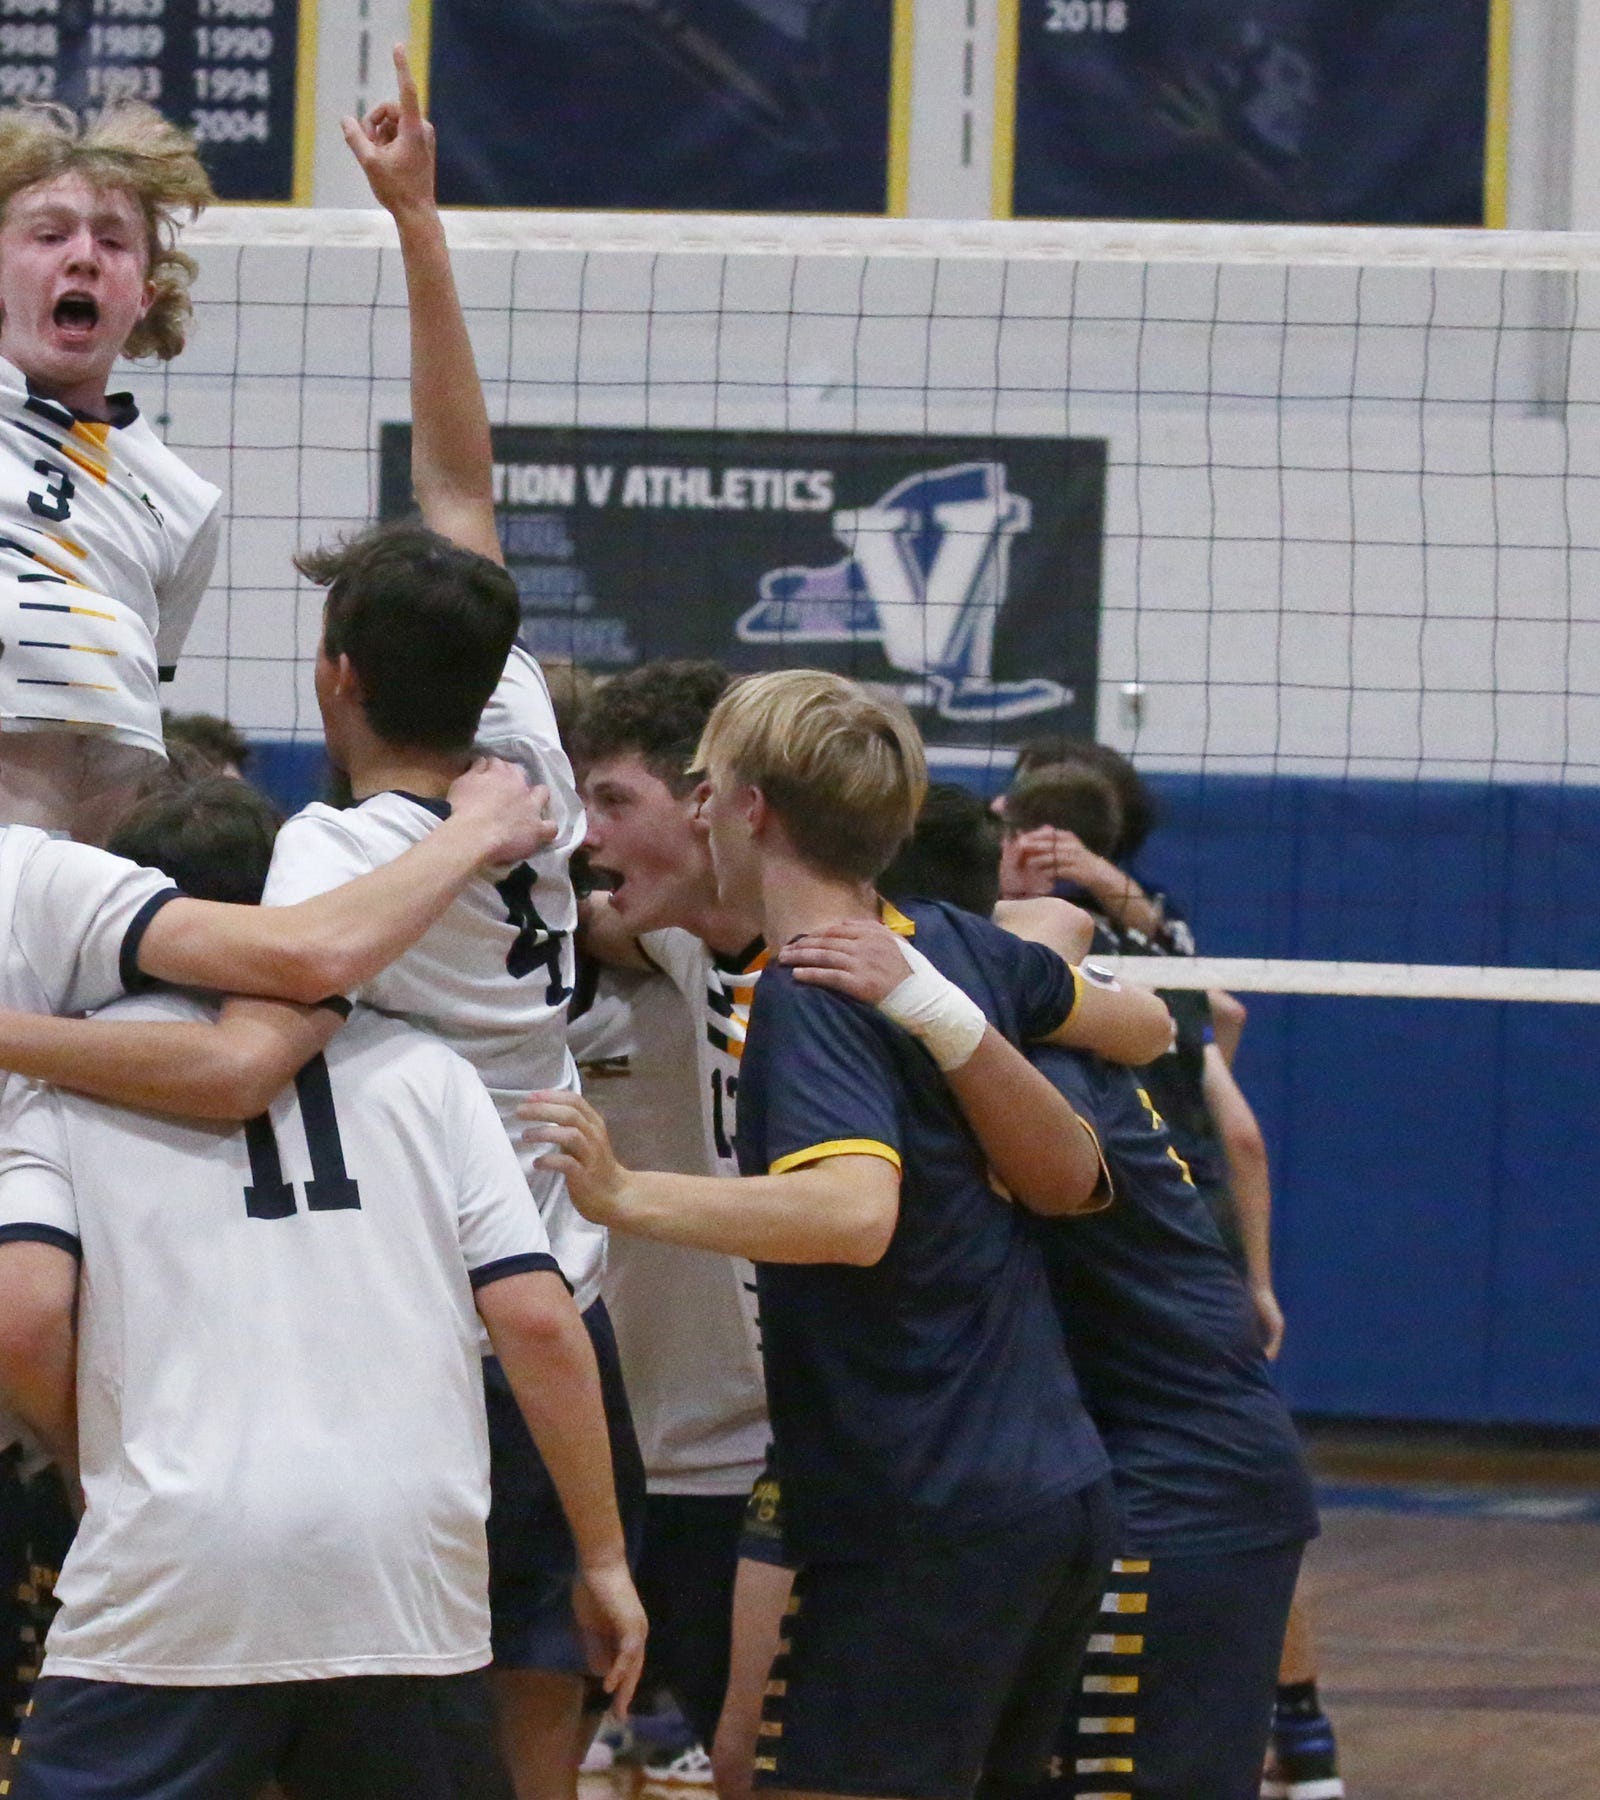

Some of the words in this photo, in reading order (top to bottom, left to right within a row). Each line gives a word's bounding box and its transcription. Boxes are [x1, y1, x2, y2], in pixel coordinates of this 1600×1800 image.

[1045, 0, 1127, 32] 2018
[90, 25, 164, 58] 1989
[195, 26, 272, 59] 1990
[87, 66, 162, 99] 1993
[193, 68, 270, 101] 1994
[193, 109, 268, 143] 2004
[27, 460, 74, 522] 3
[492, 463, 577, 507] TION
[584, 465, 615, 508] V
[621, 465, 834, 511] ATHLETICS
[244, 1051, 362, 1220] 11
